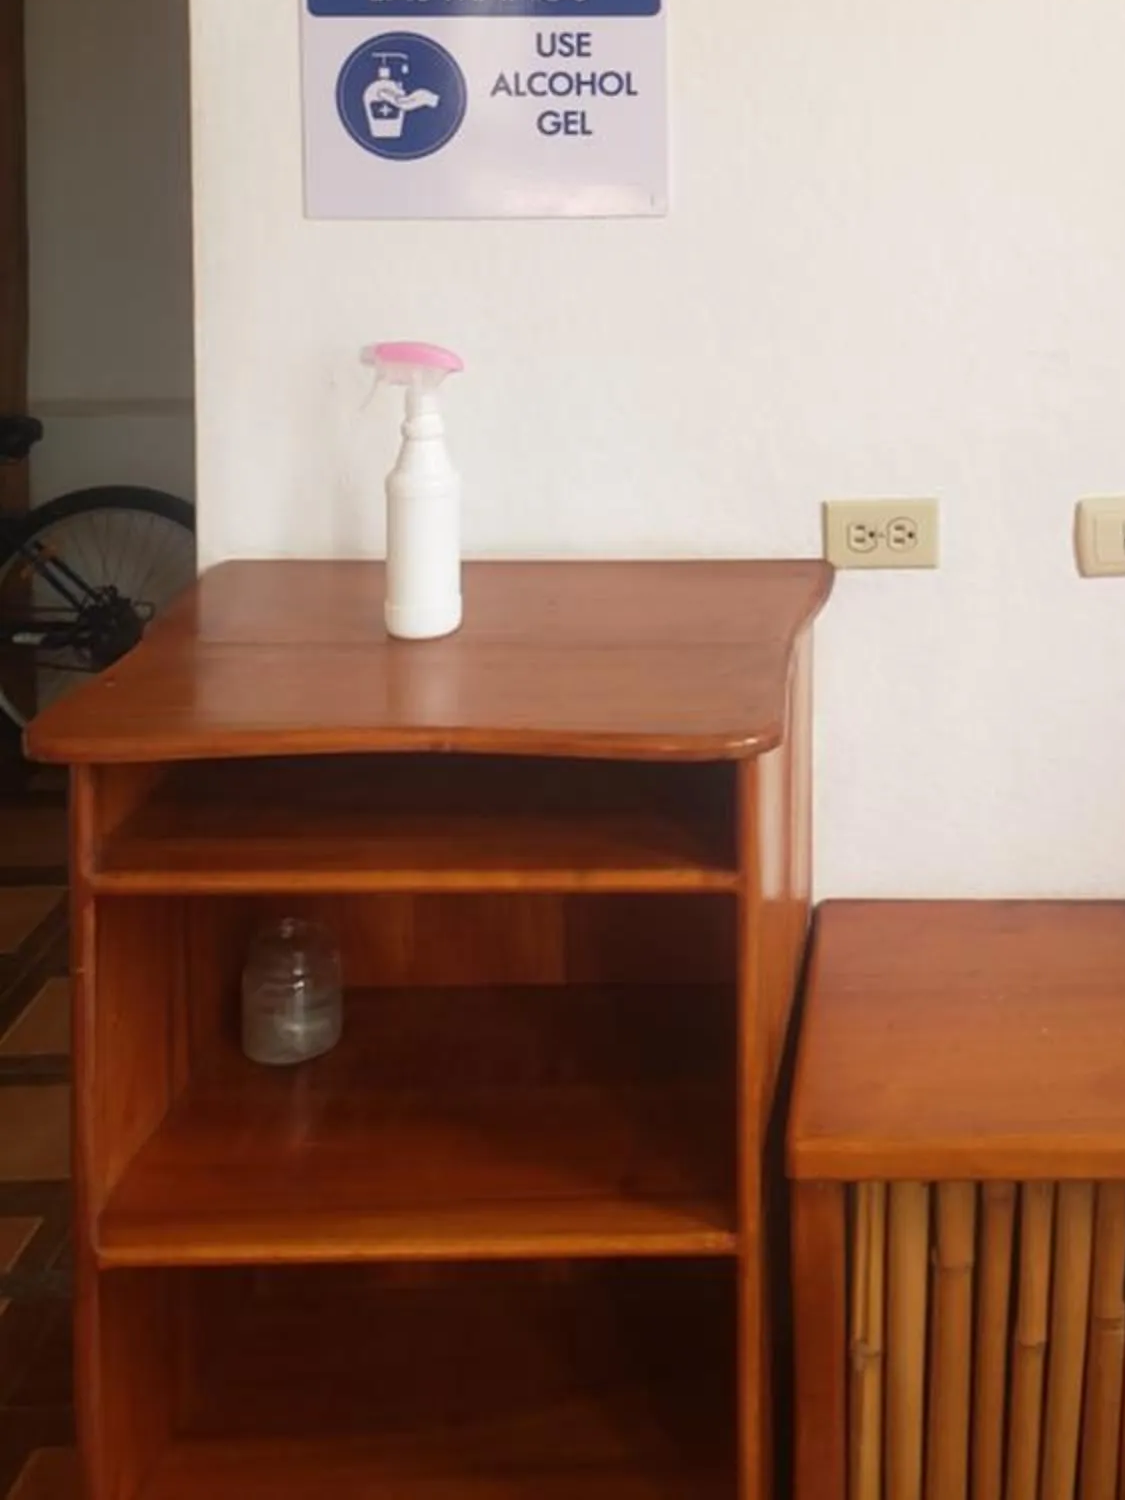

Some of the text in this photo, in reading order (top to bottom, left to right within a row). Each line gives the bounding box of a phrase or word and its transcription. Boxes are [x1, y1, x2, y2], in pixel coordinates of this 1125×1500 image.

[536, 33, 591, 57] USE
[489, 71, 638, 97] ALCOHOL
[536, 110, 593, 135] GEL
